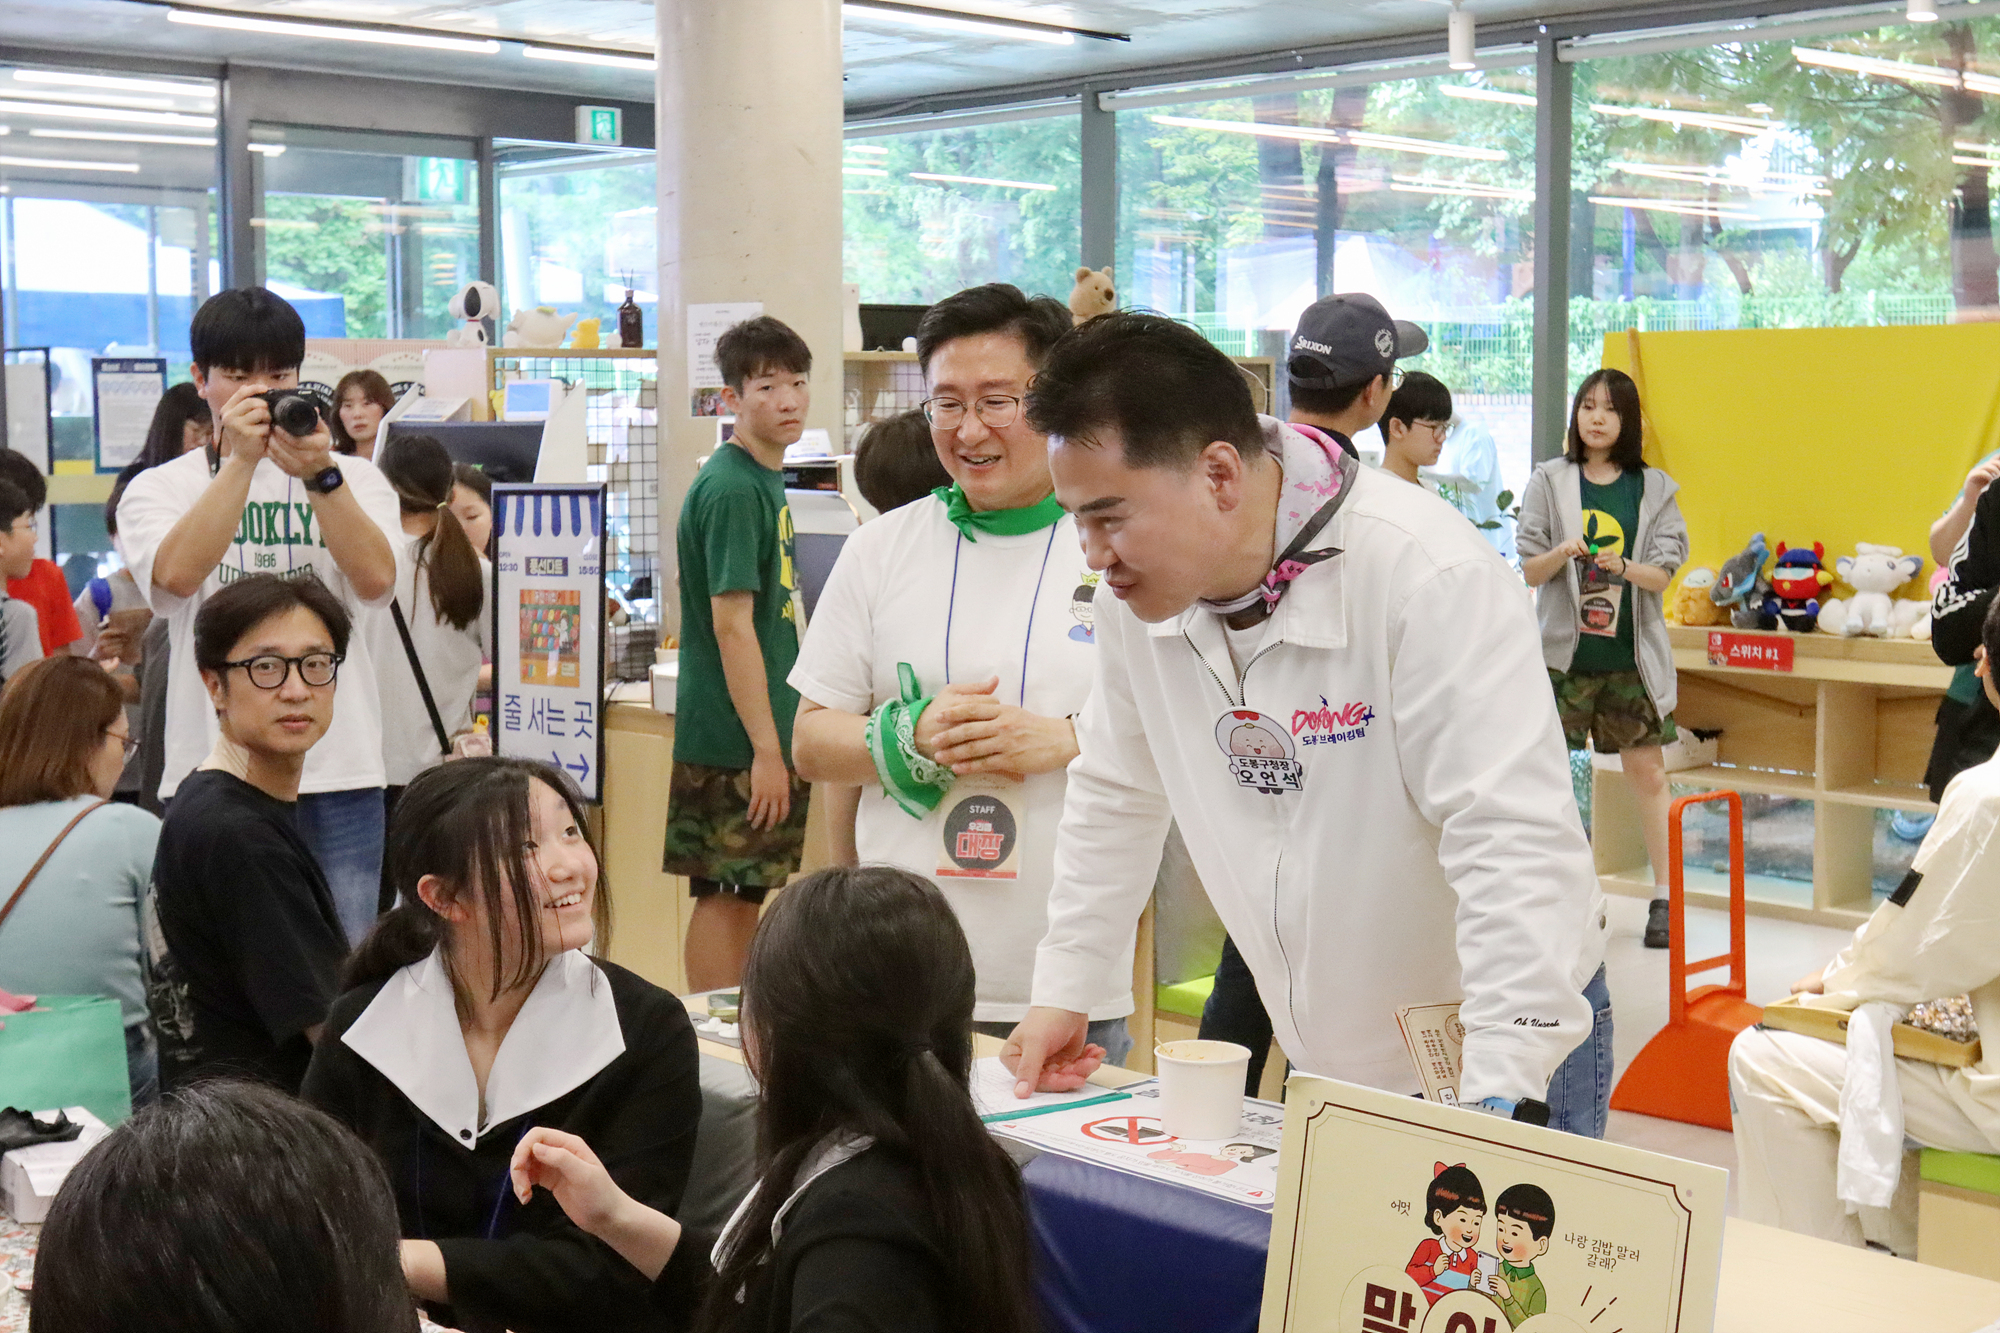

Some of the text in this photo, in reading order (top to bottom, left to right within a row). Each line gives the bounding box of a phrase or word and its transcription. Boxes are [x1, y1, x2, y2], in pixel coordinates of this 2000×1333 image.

[1295, 335, 1332, 355] SRIXON
[254, 553, 276, 568] 1986
[499, 563, 518, 572] 12:30
[1730, 644, 1779, 660] 스위치 #1
[504, 694, 593, 740] 줄 서는 곳
[1239, 758, 1290, 771] 도봉구청장
[969, 805, 995, 814] STAFF
[956, 831, 1004, 861] 대짱
[1513, 1017, 1528, 1026] Oh
[1390, 1199, 1411, 1216] 어멋
[1564, 1232, 1640, 1262] 나랑 김밥 말러
[1587, 1253, 1617, 1273] 갈래?
